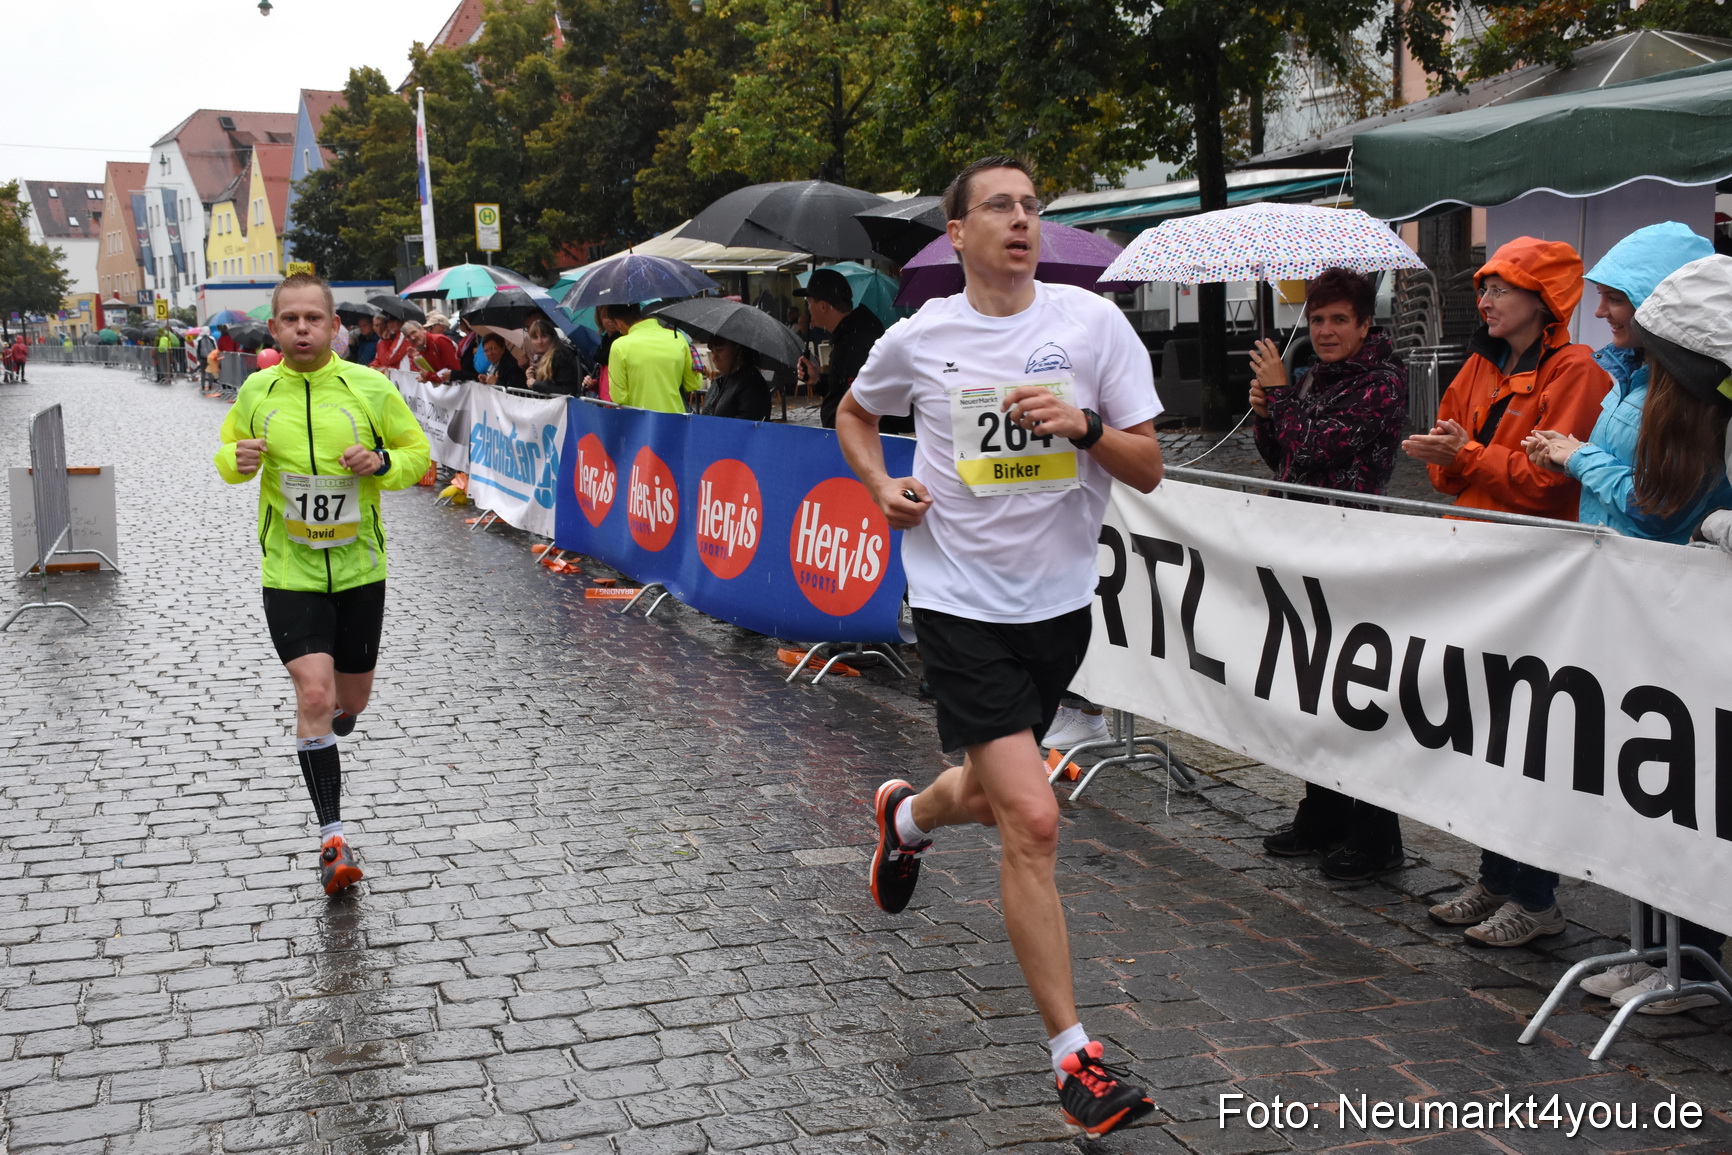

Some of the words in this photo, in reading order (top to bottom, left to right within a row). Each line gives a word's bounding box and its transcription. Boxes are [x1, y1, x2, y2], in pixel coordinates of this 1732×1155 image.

[290, 263, 312, 273] Block
[157, 304, 166, 316] D
[960, 397, 999, 406] NeuerMarkt
[993, 463, 1041, 479] Birker
[295, 493, 346, 522] 187
[629, 464, 675, 533] Hervis
[698, 479, 758, 557] Hervis
[700, 541, 728, 561] SPORTS
[796, 500, 883, 591] Hervis
[800, 570, 837, 594] SPORTS
[1096, 524, 1226, 686] RTL
